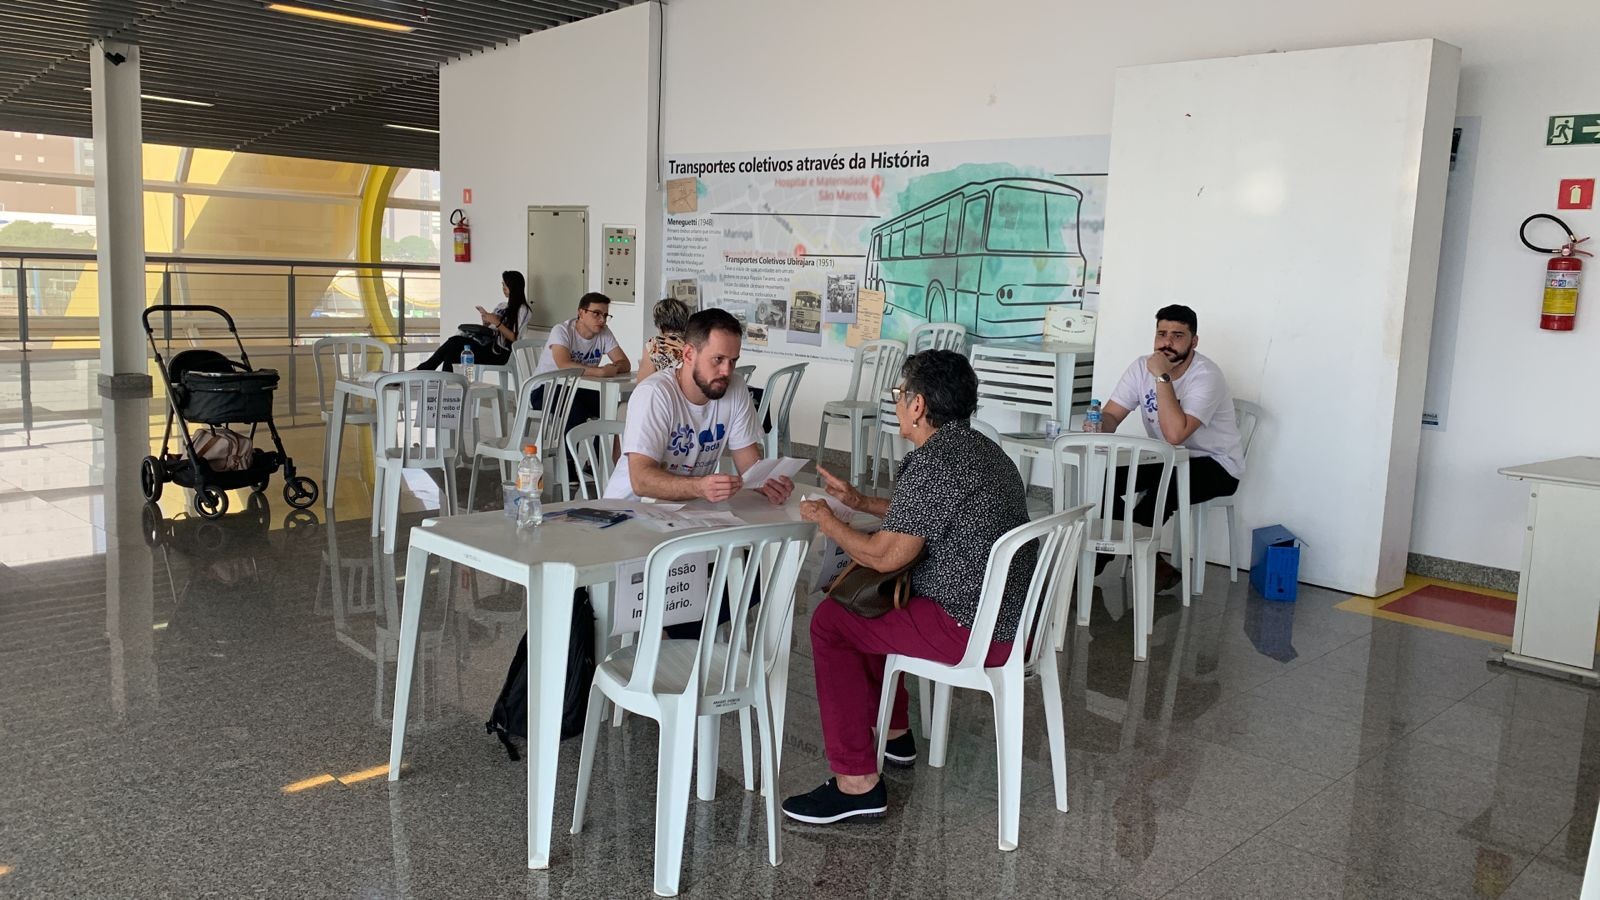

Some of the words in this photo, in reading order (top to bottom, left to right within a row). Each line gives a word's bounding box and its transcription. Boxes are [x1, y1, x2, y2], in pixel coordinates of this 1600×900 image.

[669, 159, 735, 178] Transportes
[739, 156, 793, 172] coletivos
[796, 153, 845, 171] através
[849, 152, 866, 169] da
[871, 150, 929, 168] História
[667, 218, 697, 227] Meneguetti
[725, 255, 758, 265] Transportes
[759, 256, 786, 265] Coletivos
[787, 257, 815, 267] Ubirajara
[816, 258, 835, 268] (1951)
[668, 562, 696, 577] issão
[665, 582, 690, 595] reito
